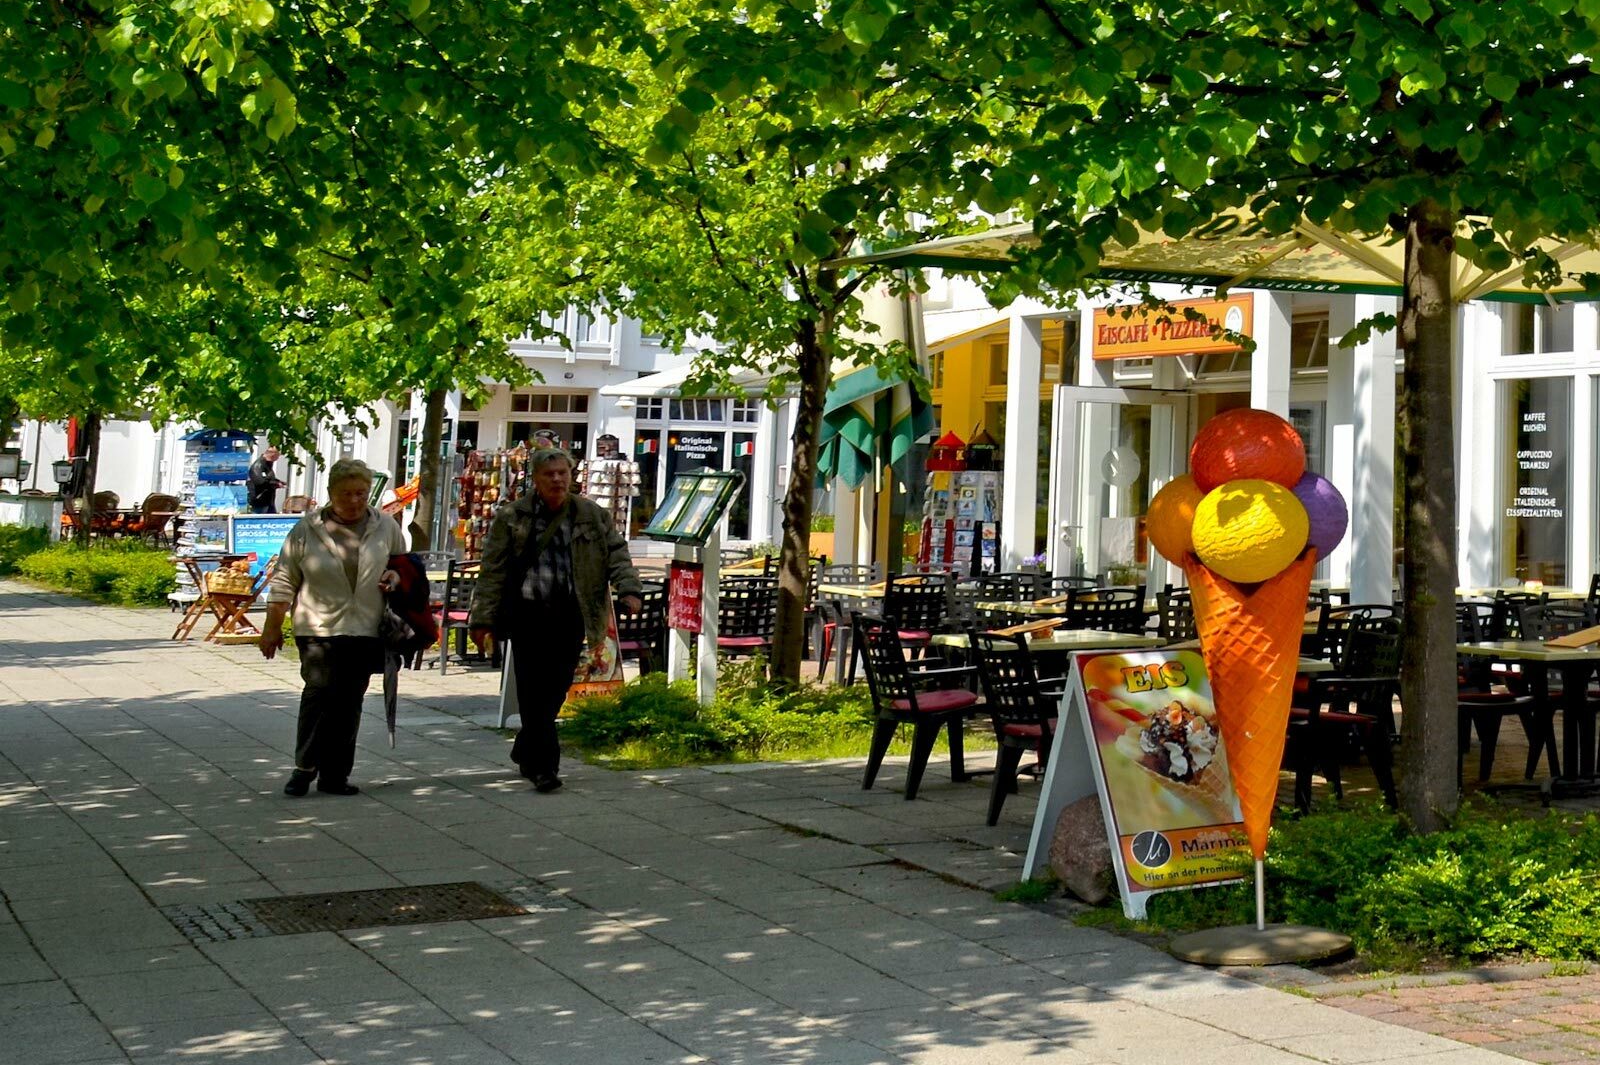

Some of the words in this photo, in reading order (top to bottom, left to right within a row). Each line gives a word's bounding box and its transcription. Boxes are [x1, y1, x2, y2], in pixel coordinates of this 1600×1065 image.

[1523, 413, 1546, 422] KAFFEE
[1516, 450, 1553, 459] CAPPUCCINO
[1120, 661, 1188, 693] EIS
[1143, 872, 1165, 882] Hier
[1182, 867, 1198, 877] der
